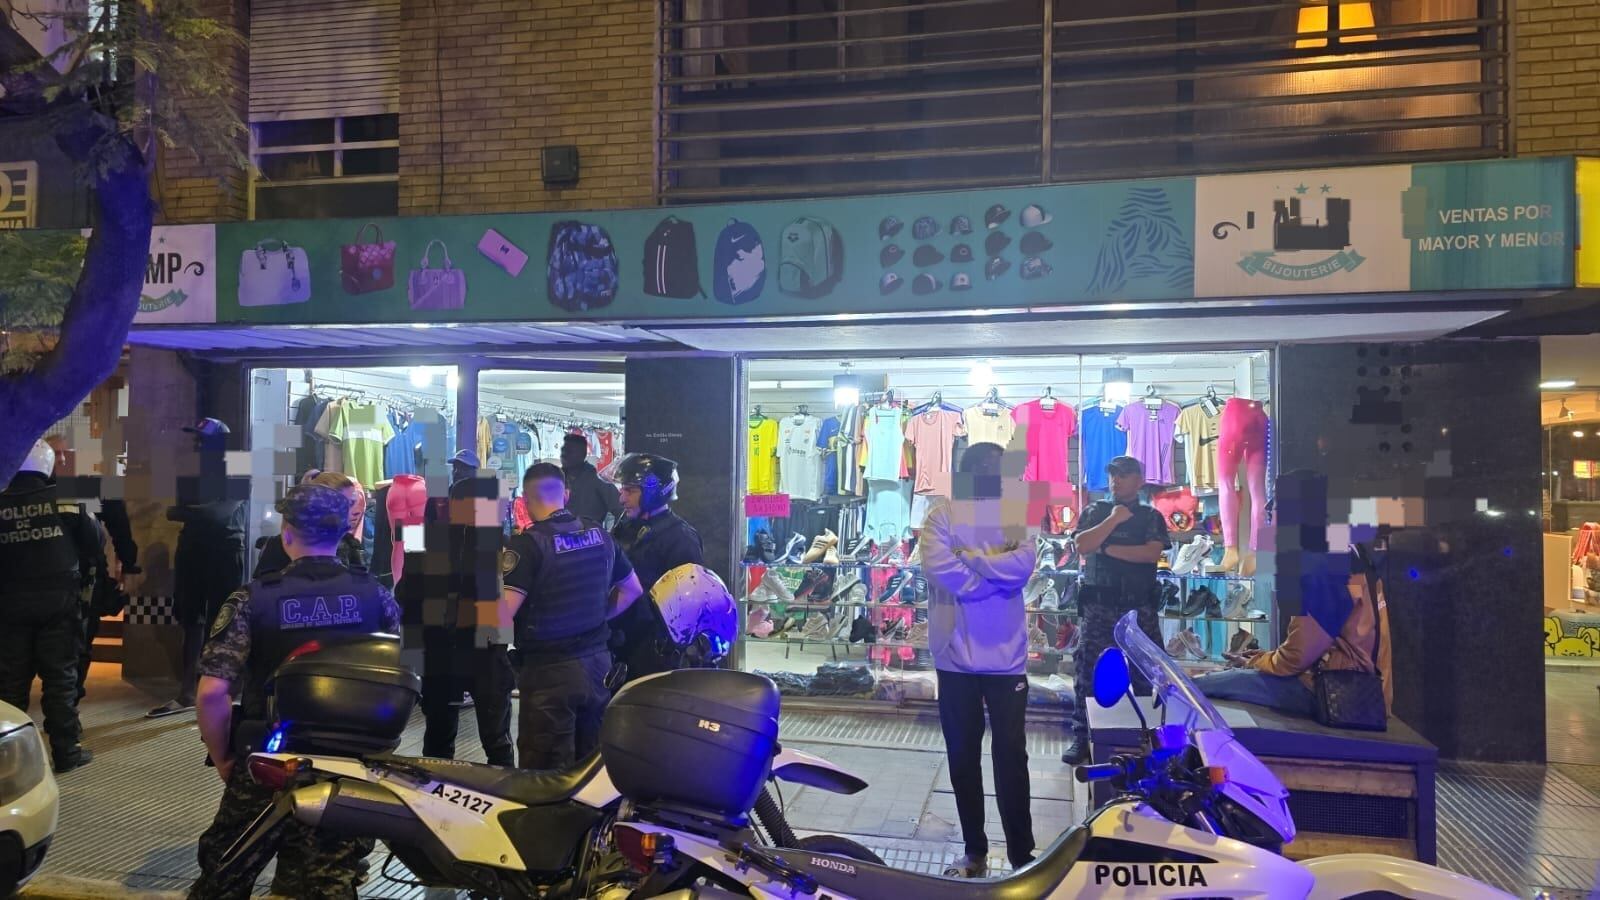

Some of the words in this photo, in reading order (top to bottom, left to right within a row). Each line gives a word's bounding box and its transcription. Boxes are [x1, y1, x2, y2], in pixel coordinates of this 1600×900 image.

[1438, 207, 1509, 225] VENTAS
[1514, 204, 1553, 220] POR
[1418, 234, 1480, 252] MAYOR
[1485, 234, 1496, 249] Y
[1500, 231, 1565, 248] MENOR
[144, 252, 182, 284] MP
[1262, 258, 1341, 278] BIJOUTERIE
[0, 502, 54, 521] OLICIA
[0, 525, 64, 544] ORDOBA
[16, 519, 32, 530] DE
[554, 529, 602, 552] POLICIA
[282, 594, 359, 624] C.A.P.
[416, 758, 473, 768] HONDA
[431, 783, 493, 815] A-2127
[810, 857, 856, 875] HONDA
[1094, 864, 1208, 887] POLICIA
